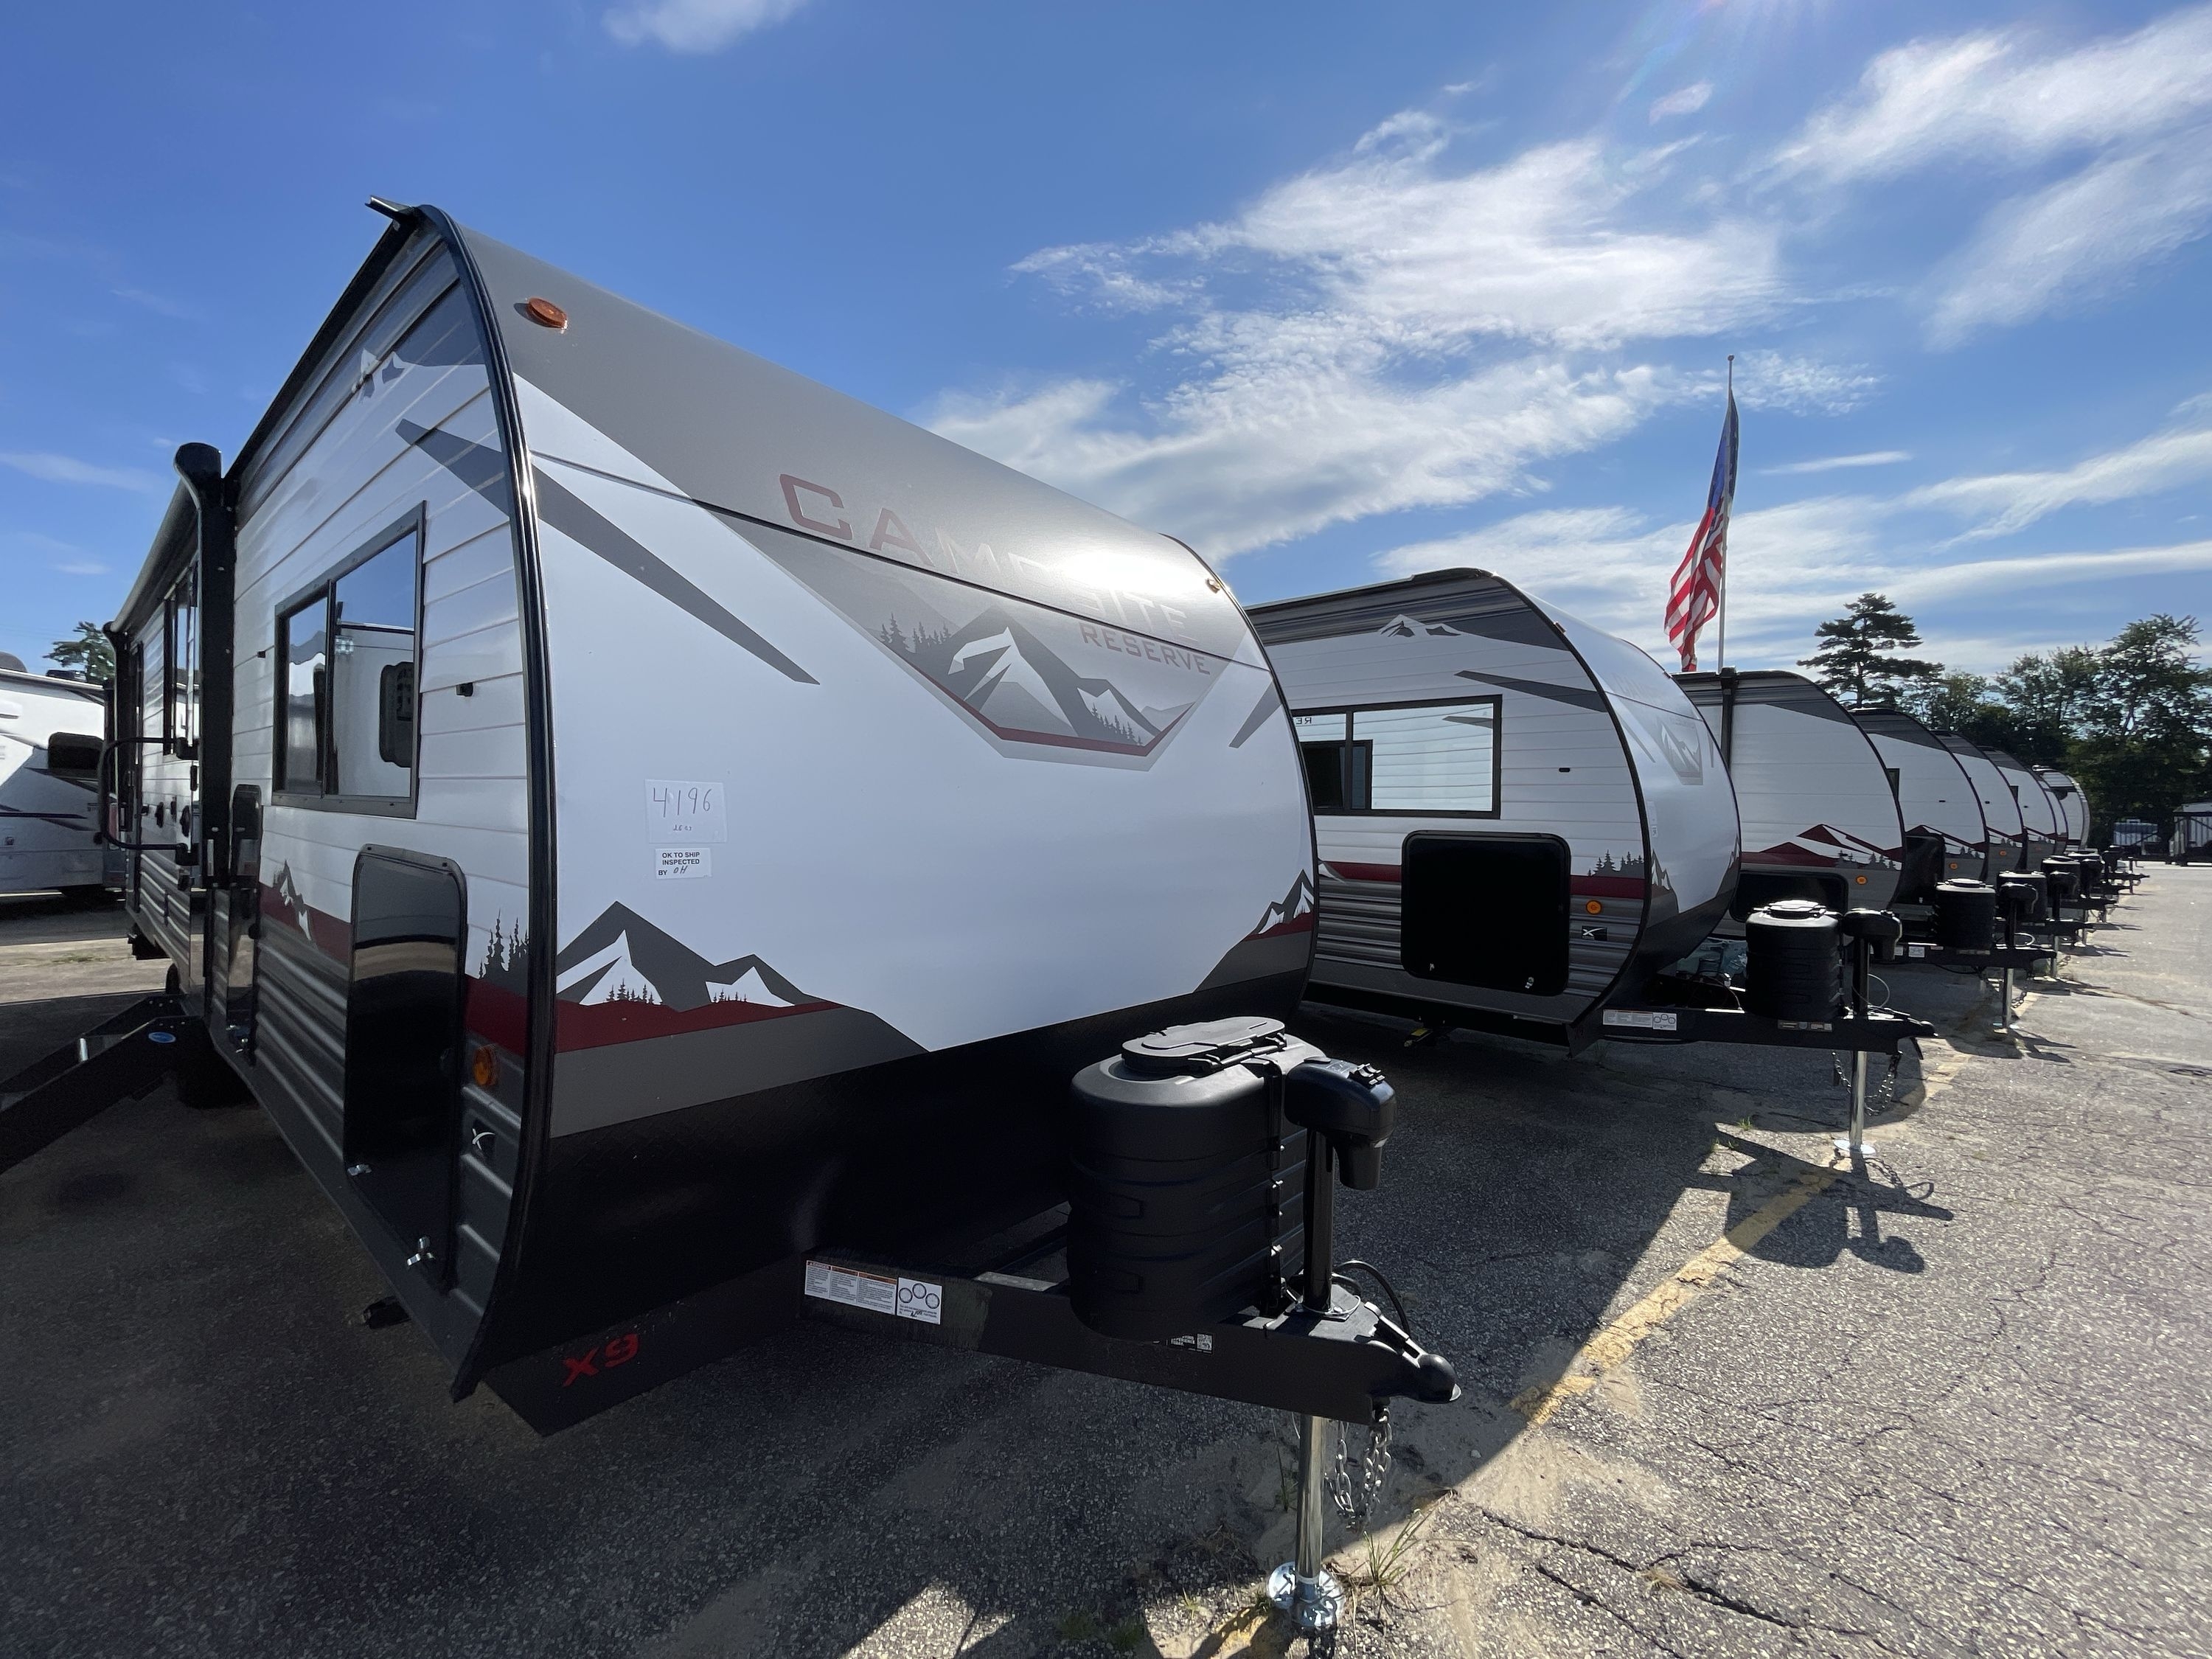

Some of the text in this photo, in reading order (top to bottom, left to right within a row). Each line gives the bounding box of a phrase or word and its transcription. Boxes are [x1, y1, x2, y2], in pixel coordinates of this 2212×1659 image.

[1079, 622, 1211, 676] RESERVE
[653, 787, 712, 818] 4196
[560, 1332, 639, 1387] X9
